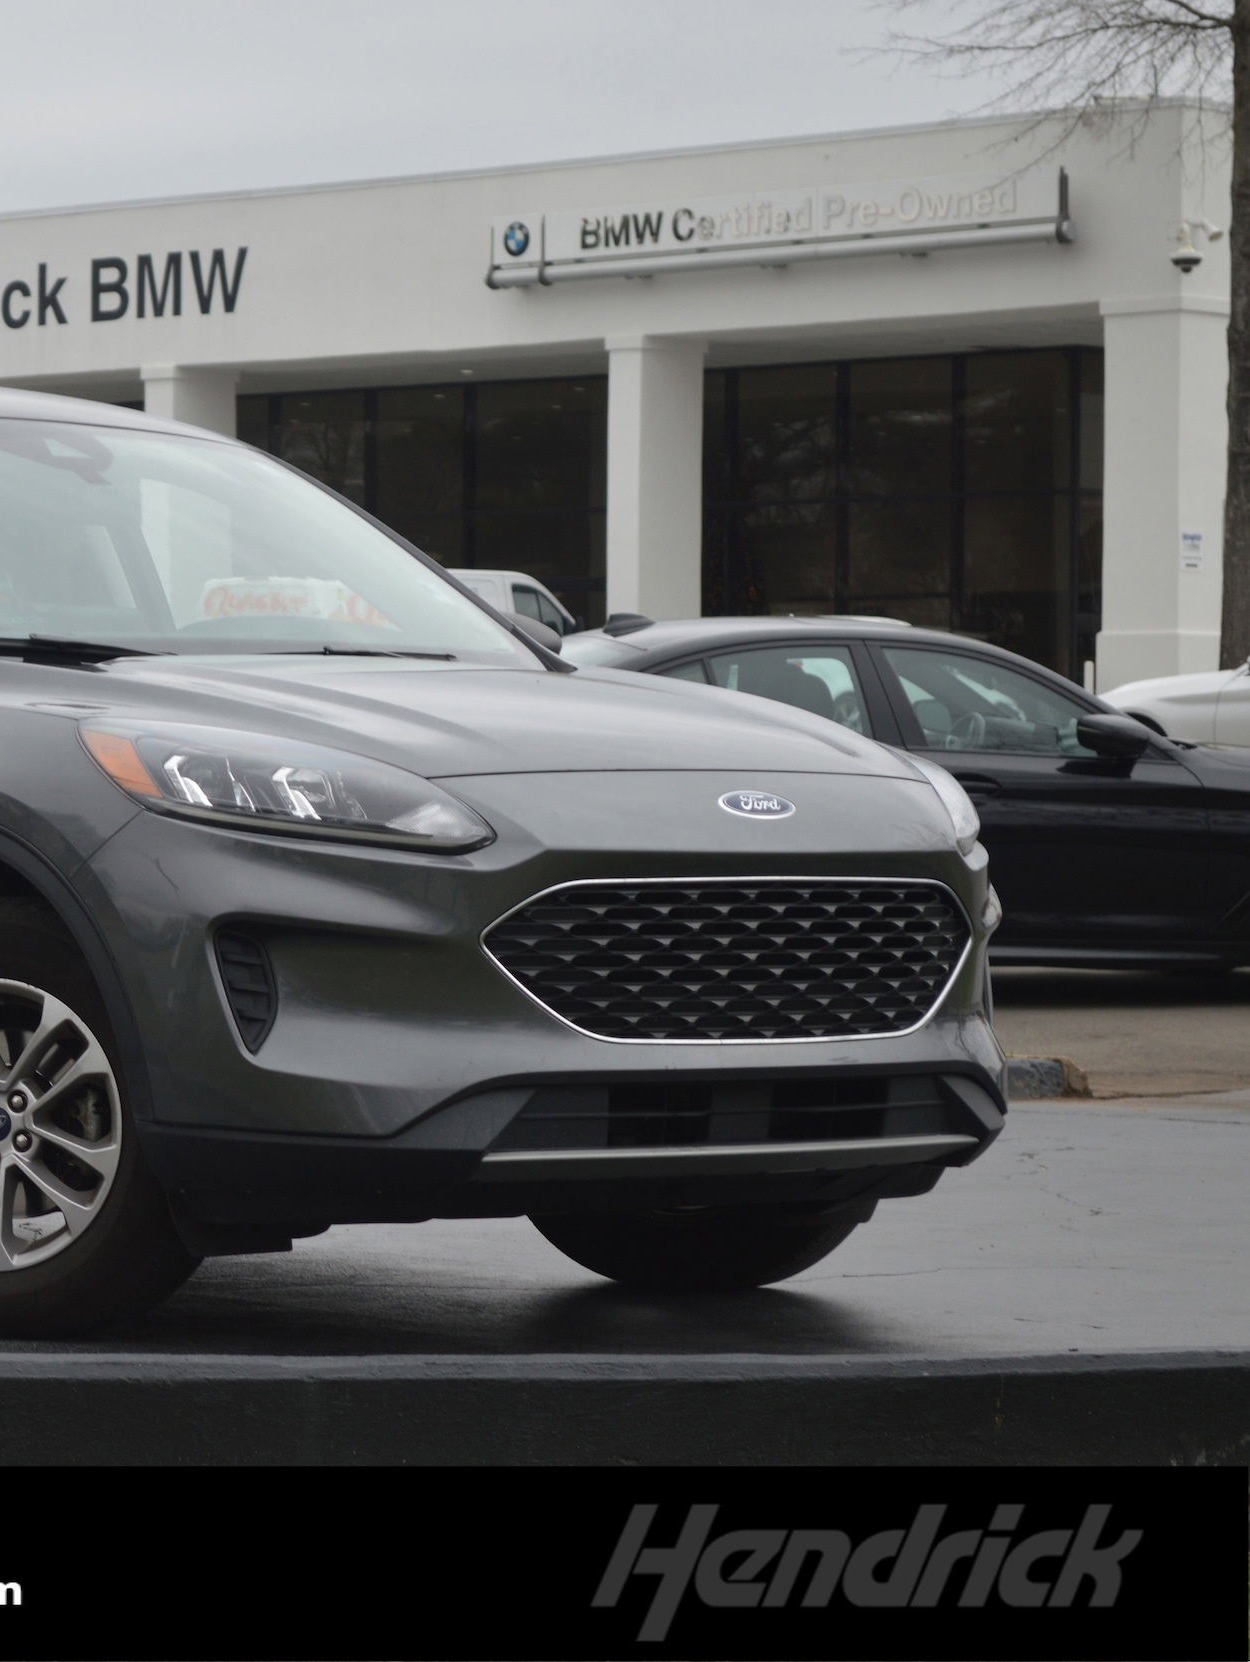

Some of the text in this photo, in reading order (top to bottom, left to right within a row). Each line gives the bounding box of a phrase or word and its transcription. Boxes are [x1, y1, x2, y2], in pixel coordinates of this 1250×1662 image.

[580, 178, 1017, 250] BMW Certified Pre-Owned
[90, 246, 249, 322] BMW
[739, 795, 781, 811] Ford
